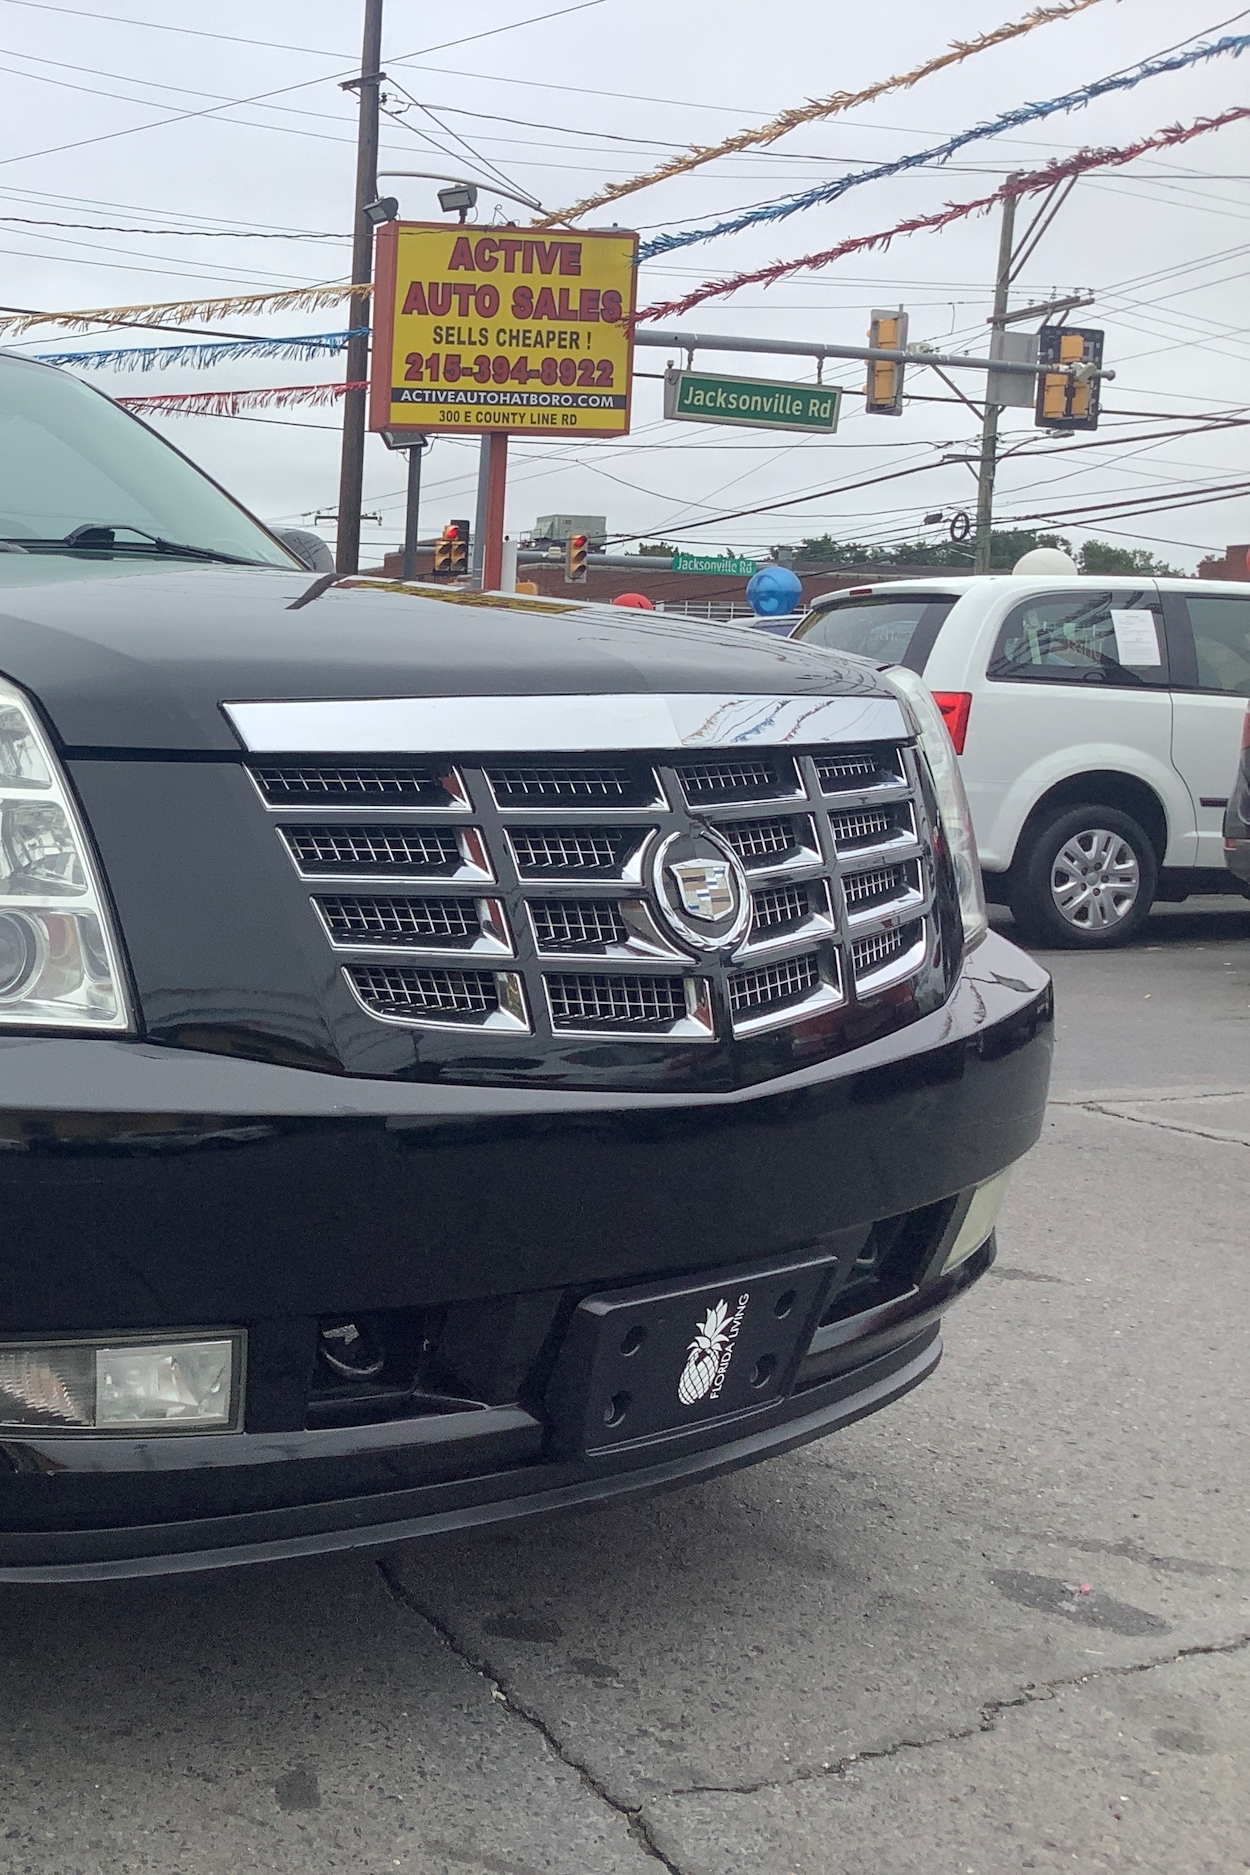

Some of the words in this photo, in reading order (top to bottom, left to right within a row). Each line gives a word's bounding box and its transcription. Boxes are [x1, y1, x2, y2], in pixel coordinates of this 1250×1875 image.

[447, 236, 582, 276] ACTIVE
[401, 281, 500, 319] AUTO
[511, 285, 624, 324] SALES
[432, 325, 489, 347] SELLS
[496, 328, 581, 350] CHEAPER
[404, 352, 614, 388] 215-394-8922
[400, 390, 614, 408] ACTIVEAUTOHATBORO.COM
[683, 386, 803, 415] Jacksonville
[808, 398, 832, 419] Rd
[439, 410, 460, 423] 300
[464, 411, 472, 423] E
[475, 411, 526, 425] COUNTY
[530, 413, 558, 425] LINE
[561, 414, 578, 426] RD
[677, 557, 738, 573] Jacksonville
[739, 560, 753, 574] Rd
[710, 1342, 735, 1400] FLORIDA
[729, 1292, 750, 1339] LIVING
